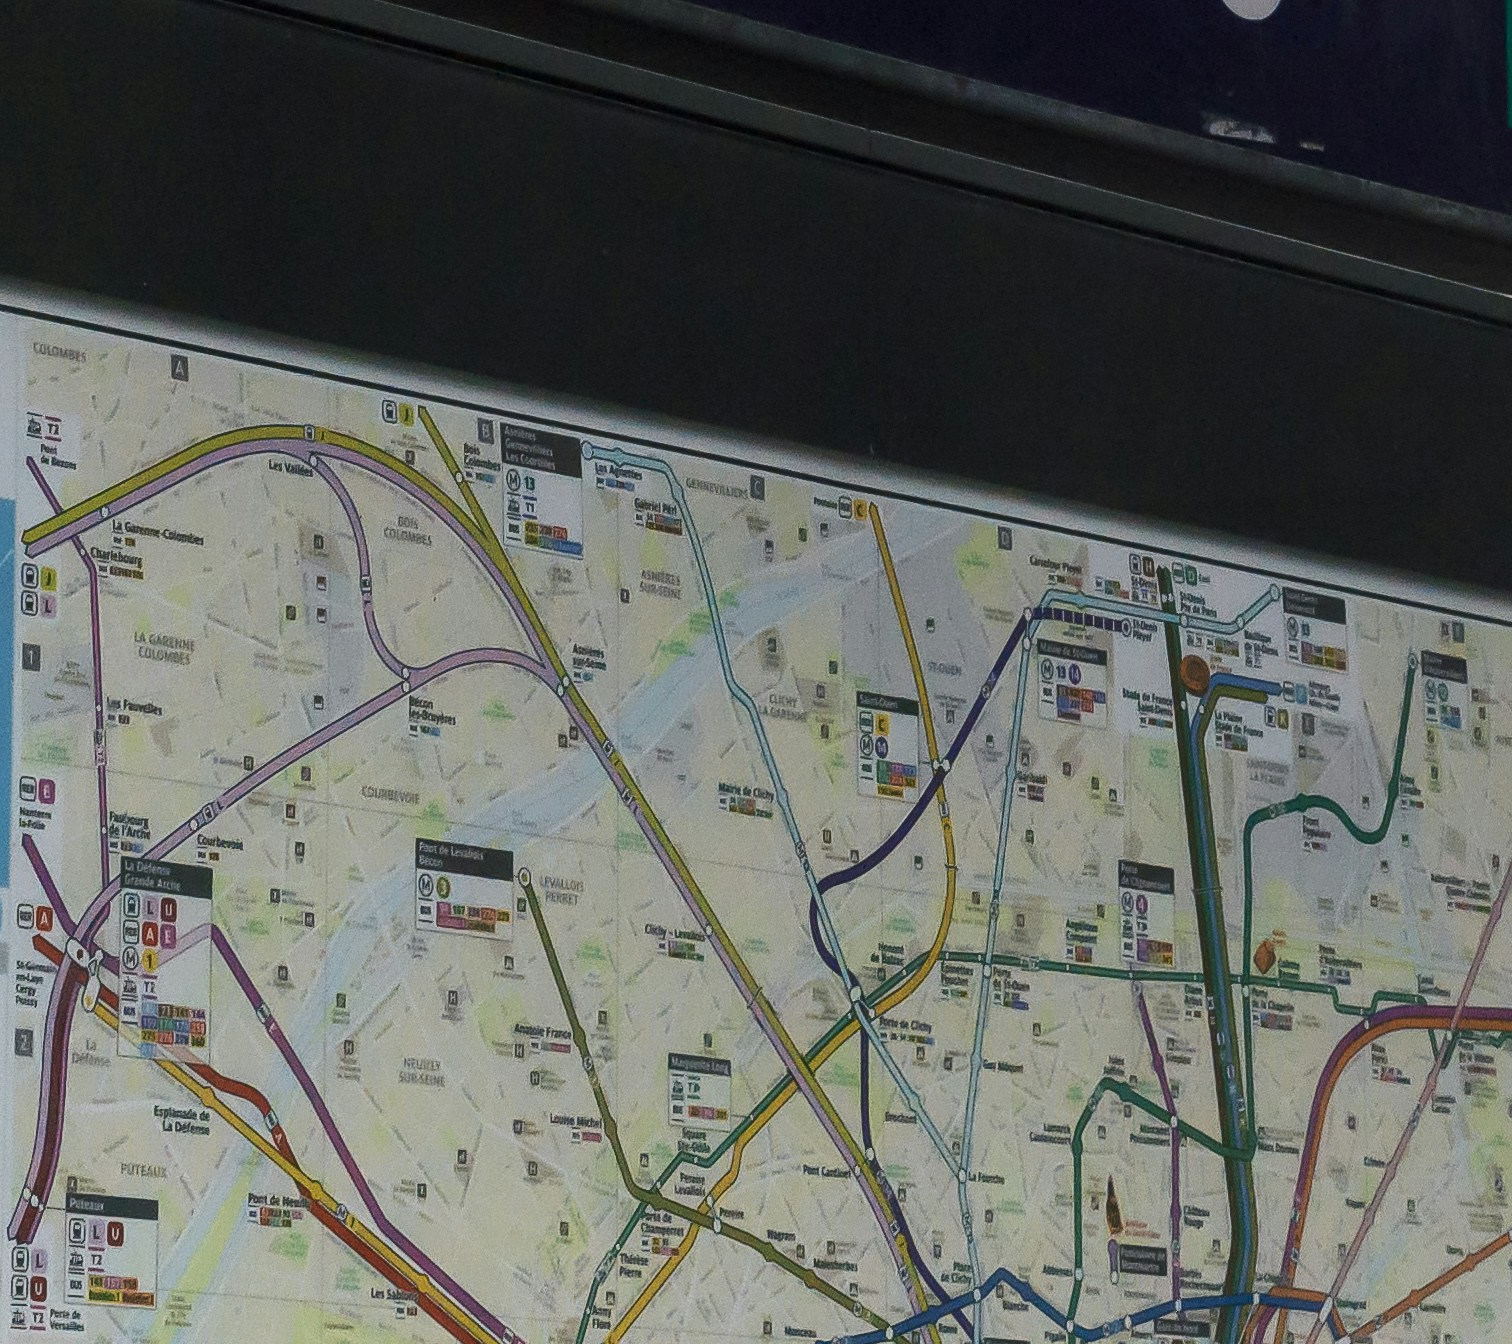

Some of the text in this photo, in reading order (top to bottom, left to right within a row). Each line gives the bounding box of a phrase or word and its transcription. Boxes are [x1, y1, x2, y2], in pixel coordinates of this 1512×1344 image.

[33, 342, 86, 362] COLOMBES
[269, 460, 313, 477] Les Vallées
[113, 520, 122, 531] La
[1056, 665, 1066, 678] 13
[197, 834, 243, 850] Courbevoie
[124, 874, 155, 888] Grande
[540, 875, 584, 892] LEVALLOIS
[154, 1106, 209, 1120] Esplanade de
[163, 1120, 172, 1132] La
[121, 1163, 166, 1178] PUTEAUX
[248, 1193, 268, 1205] Pont
[92, 1255, 102, 1266] T2
[371, 1288, 384, 1298] Les
